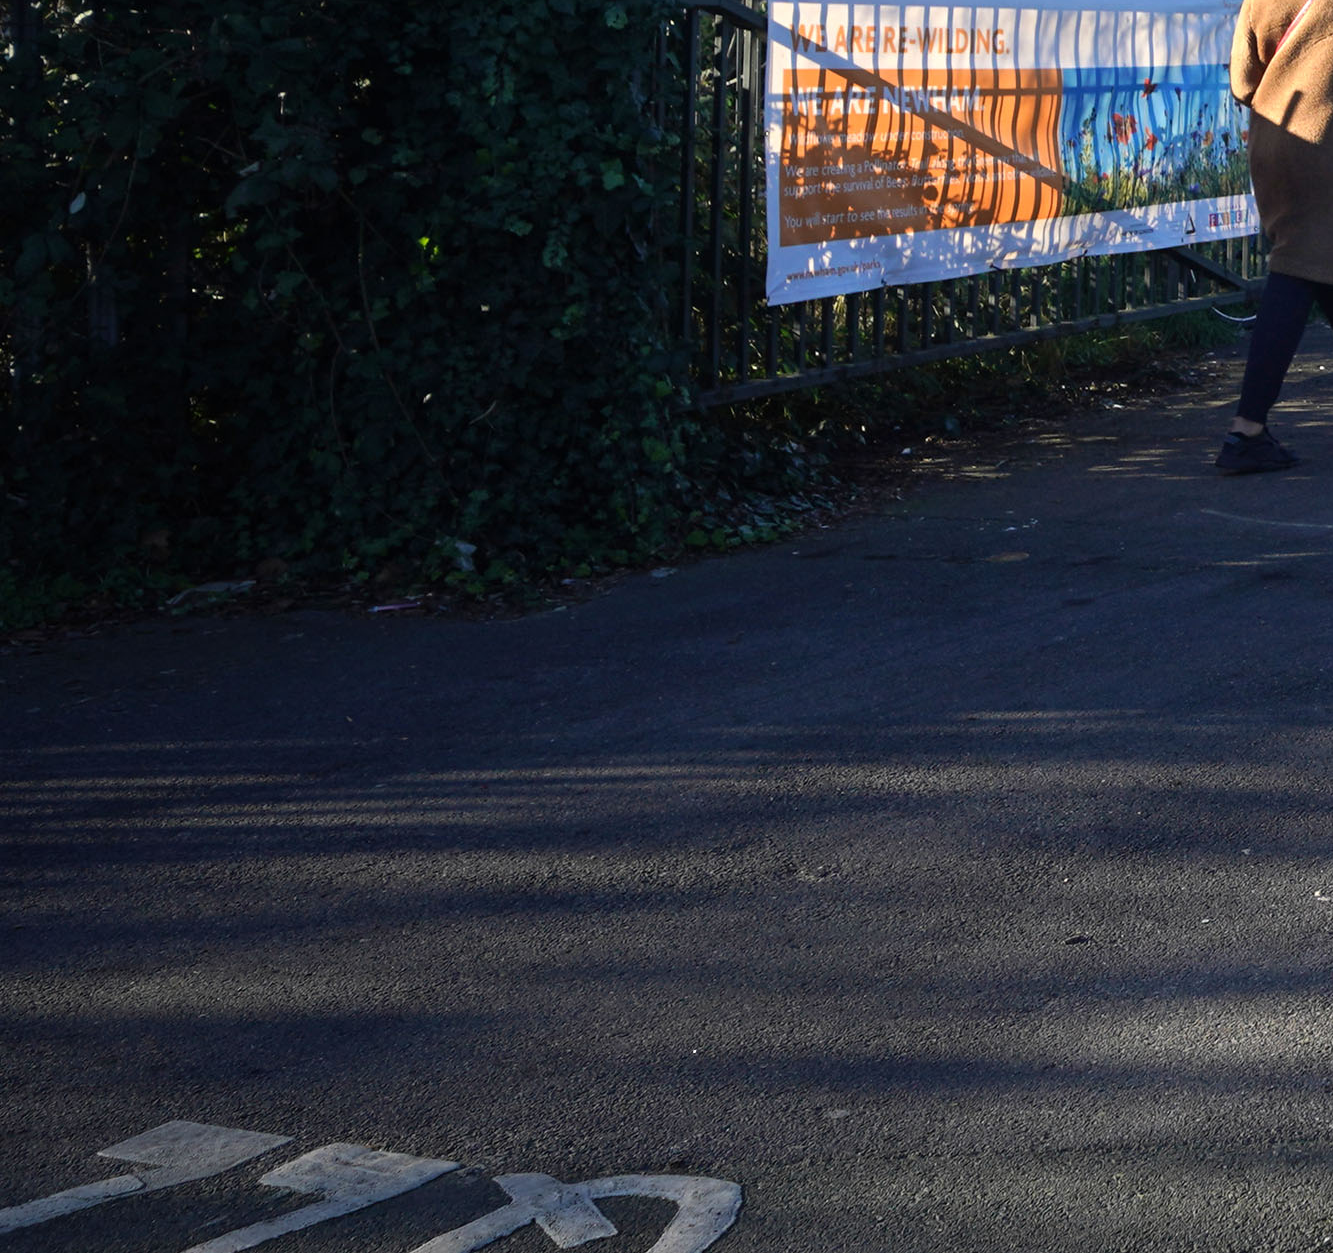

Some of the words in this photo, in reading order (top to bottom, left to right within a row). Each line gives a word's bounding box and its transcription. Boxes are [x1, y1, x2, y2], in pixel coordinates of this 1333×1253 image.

[790, 24, 828, 52] WE
[834, 25, 876, 52] ARE
[883, 26, 1010, 55] RE-WILDING.
[788, 86, 825, 116] WE
[830, 86, 877, 115] ARE
[883, 86, 985, 114] NEWHAM.
[785, 165, 804, 178] We
[822, 161, 856, 178] creating
[784, 183, 821, 200] support
[785, 215, 802, 228] You
[822, 210, 843, 224] start
[847, 210, 858, 222] to
[860, 210, 875, 221] see
